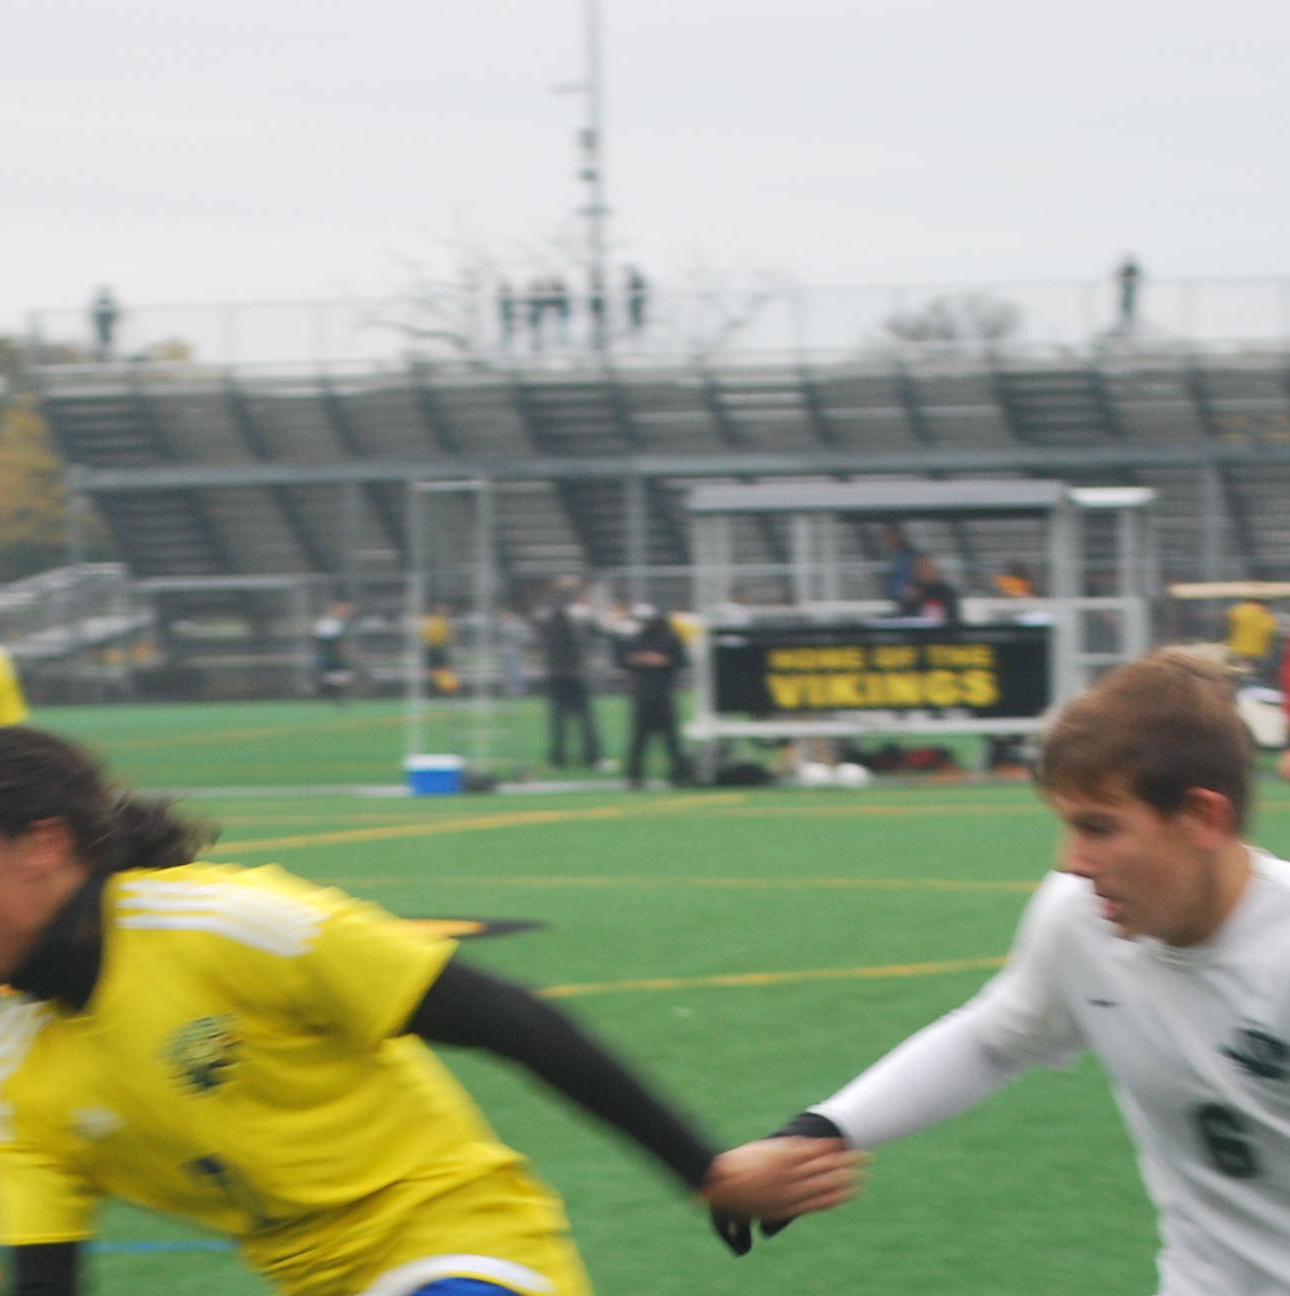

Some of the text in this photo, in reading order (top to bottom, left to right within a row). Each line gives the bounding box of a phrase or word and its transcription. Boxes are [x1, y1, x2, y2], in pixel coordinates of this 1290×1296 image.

[766, 642, 995, 669] HOME OF THE
[765, 668, 1000, 708] VIKINGS
[1197, 1102, 1259, 1180] 6
